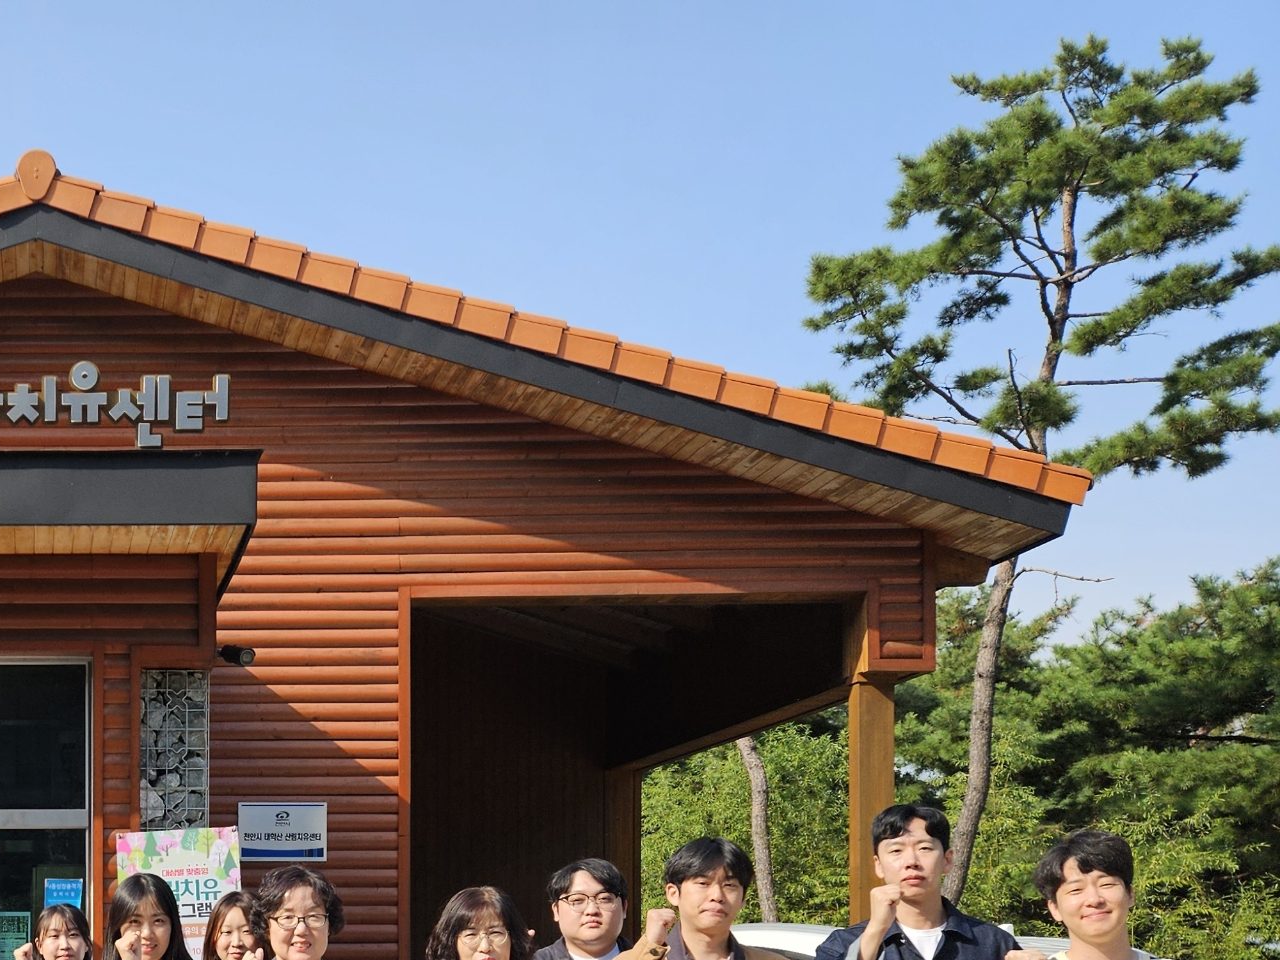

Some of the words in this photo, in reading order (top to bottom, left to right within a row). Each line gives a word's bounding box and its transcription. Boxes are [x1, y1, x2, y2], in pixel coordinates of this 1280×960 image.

[244, 832, 262, 841] 천안시
[264, 832, 283, 841] 태학산
[285, 832, 322, 841] 산림치유센터
[162, 869, 184, 877] 대상별
[186, 867, 209, 876] 맞춤형
[177, 902, 213, 918] 그램
